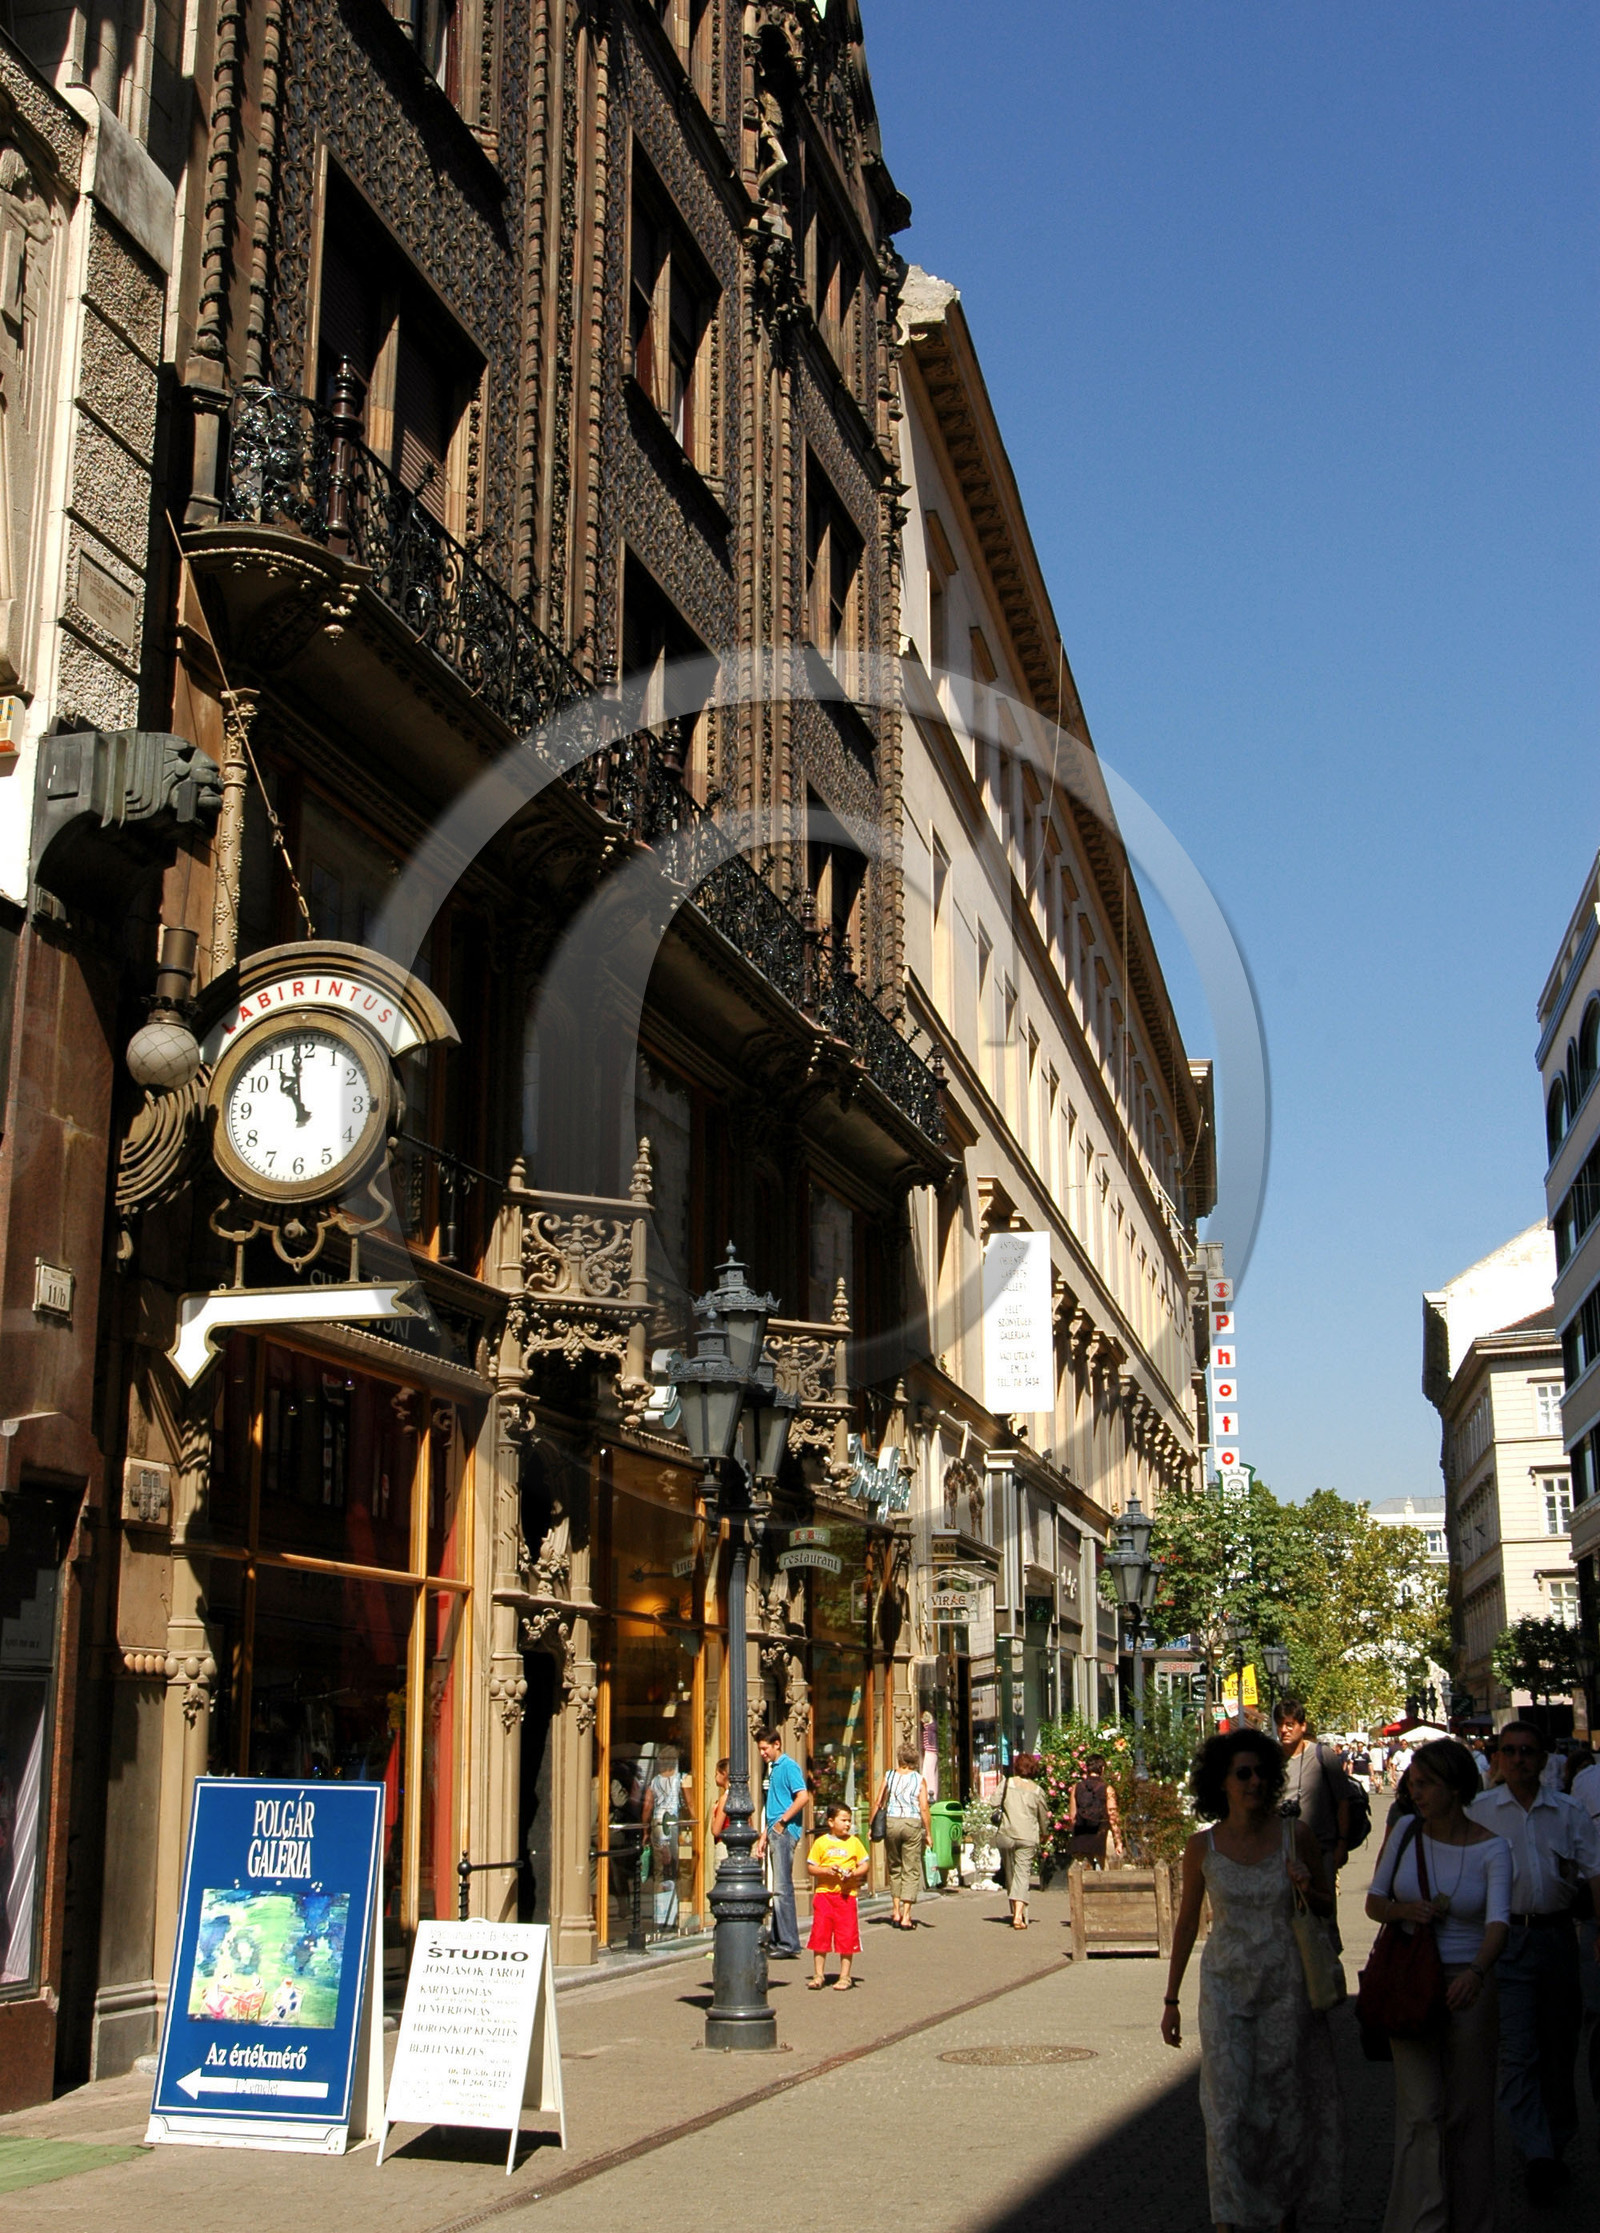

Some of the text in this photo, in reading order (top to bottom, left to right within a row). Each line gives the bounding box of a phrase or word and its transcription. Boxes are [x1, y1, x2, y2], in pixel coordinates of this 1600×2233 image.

[221, 979, 393, 1035] LABIRINTUS
[330, 1050, 337, 1066] 1
[249, 1075, 269, 1093] 10
[346, 1069, 357, 1086] 2
[240, 1102, 252, 1120] 9
[352, 1096, 363, 1113] 3
[246, 1129, 258, 1147] 8
[342, 1126, 354, 1142] 4
[265, 1151, 277, 1168] 7
[321, 1148, 333, 1165] 5
[292, 1157, 304, 1175] 6
[48, 1284, 66, 1308] 11/b
[1215, 1314, 1235, 1466] photo
[783, 1551, 838, 1571] restaurant
[1162, 1663, 1194, 1672] ESPRIT
[1227, 1687, 1256, 1697] TORS
[251, 1790, 315, 1838] POLGÁR
[247, 1830, 312, 1879] GALÉRIA
[427, 1947, 529, 1962] STUDIO
[205, 2042, 309, 2070] Az értékmérő
